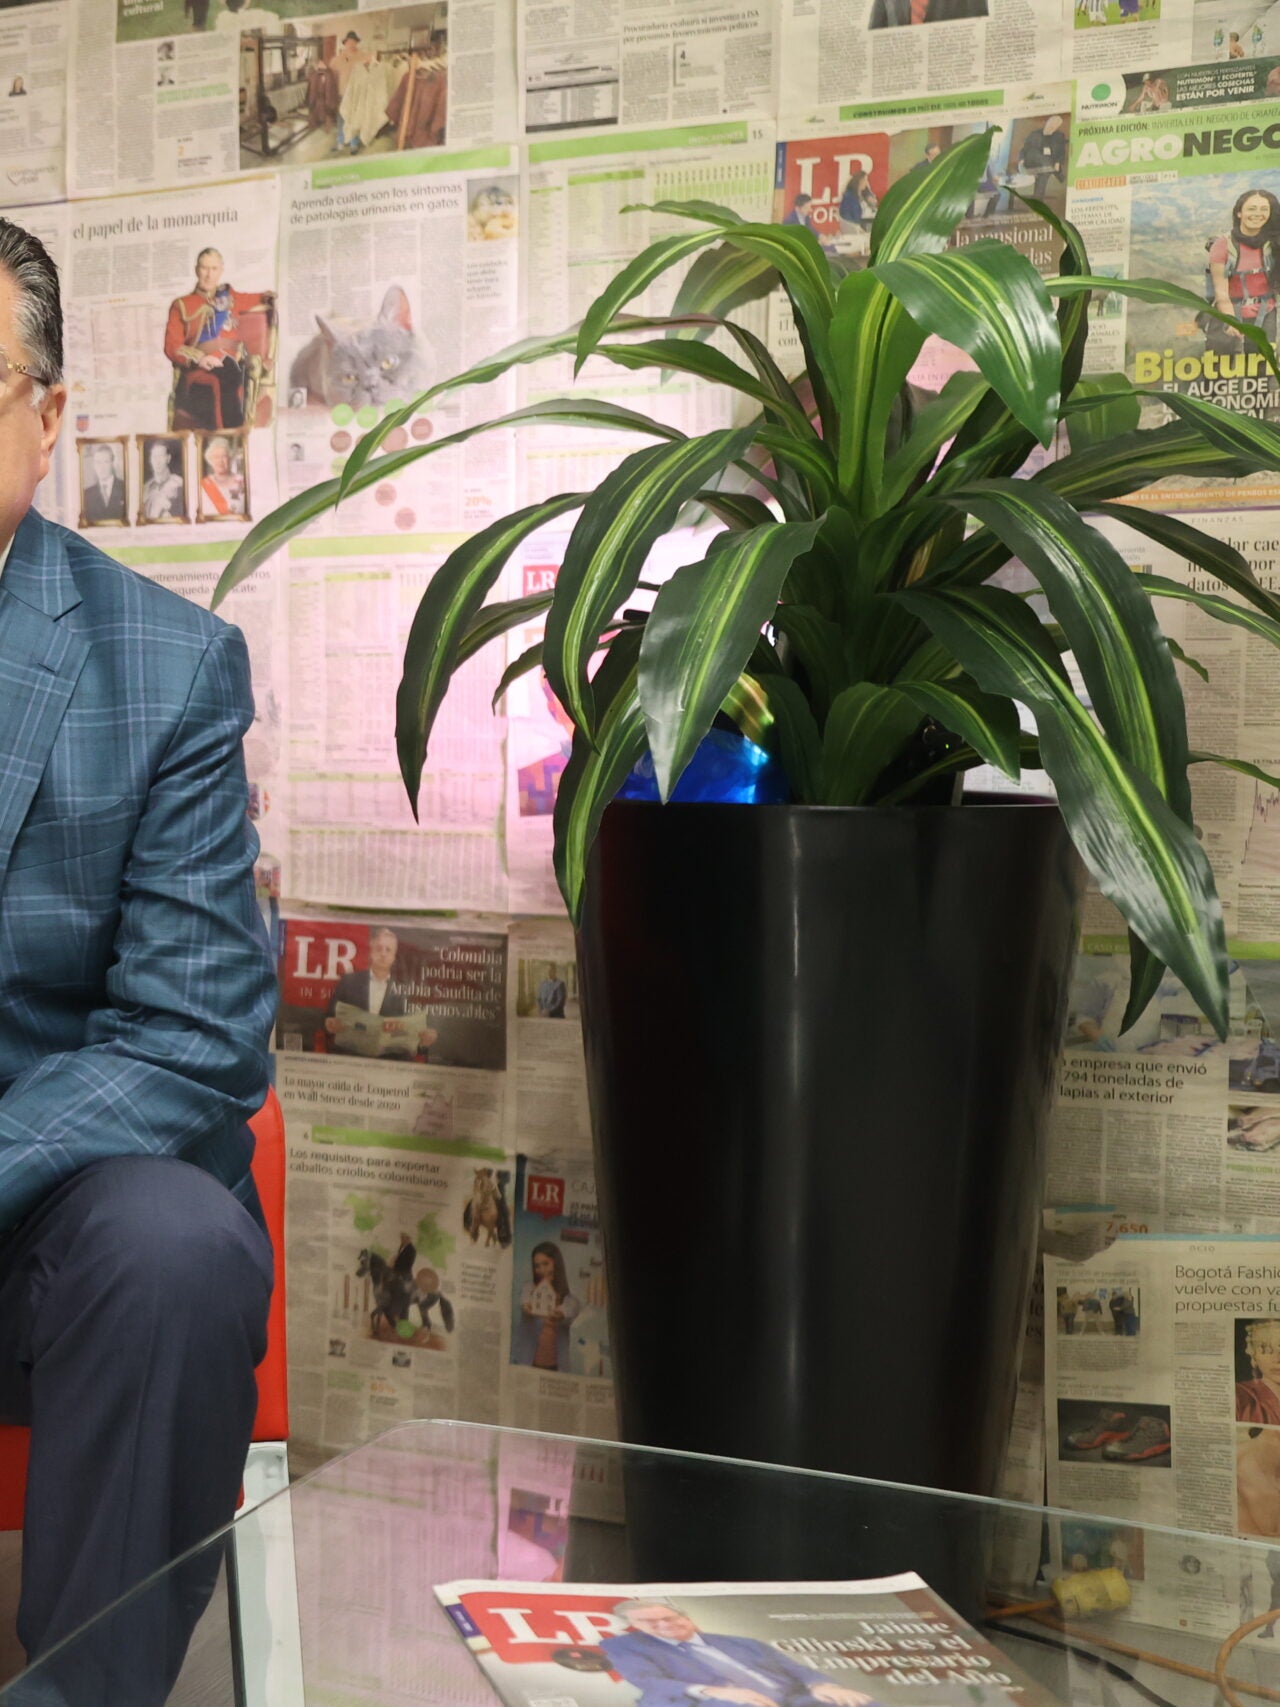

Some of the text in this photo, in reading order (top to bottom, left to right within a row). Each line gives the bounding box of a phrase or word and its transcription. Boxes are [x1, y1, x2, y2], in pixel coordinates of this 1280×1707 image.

[1176, 85, 1255, 102] ESTÁN POR VENIR
[1188, 78, 1255, 92] MEJORES COSECHAS
[752, 129, 763, 140] 15
[1078, 113, 1238, 137] PRÓXIMA INVIERTA NEGOCIO
[290, 182, 463, 211] Aprenda cuáles son los síntomas
[290, 197, 459, 225] de patologías urinarias gatos
[73, 206, 239, 241] el papel de la monarquía
[1187, 377, 1268, 396] AUGE DE
[1161, 489, 1268, 500] ENTRENAMIENTO PERROS
[1191, 515, 1244, 525] FINANZAS
[526, 570, 555, 590] LR
[293, 936, 357, 981] LR
[434, 947, 503, 965] "Colombia
[422, 965, 503, 984] podría ser la
[390, 980, 503, 1001] Arabia Saudita de
[404, 1000, 422, 1014] las
[1070, 1057, 1207, 1075] empresa que envió
[297, 1079, 410, 1098] mayor caída Ecopetrol
[1092, 1070, 1184, 1088] toneladas de
[298, 1090, 401, 1112] Wall Street desde 2020
[1103, 1087, 1175, 1104] al exterior
[289, 1148, 440, 1174] Los requisitos para exportar
[289, 1161, 448, 1189] caballos criollos colombianos
[532, 1182, 560, 1203] LR
[1175, 1264, 1232, 1281] Bogotá
[1175, 1281, 1261, 1296] vuelve con
[1175, 1299, 1263, 1314] propuestas
[487, 1608, 631, 1647] LR
[859, 1621, 953, 1636] Jaime
[770, 1635, 973, 1653] Gilinski es el
[803, 1652, 992, 1672] Empresario
[886, 1668, 1013, 1687] del Año
